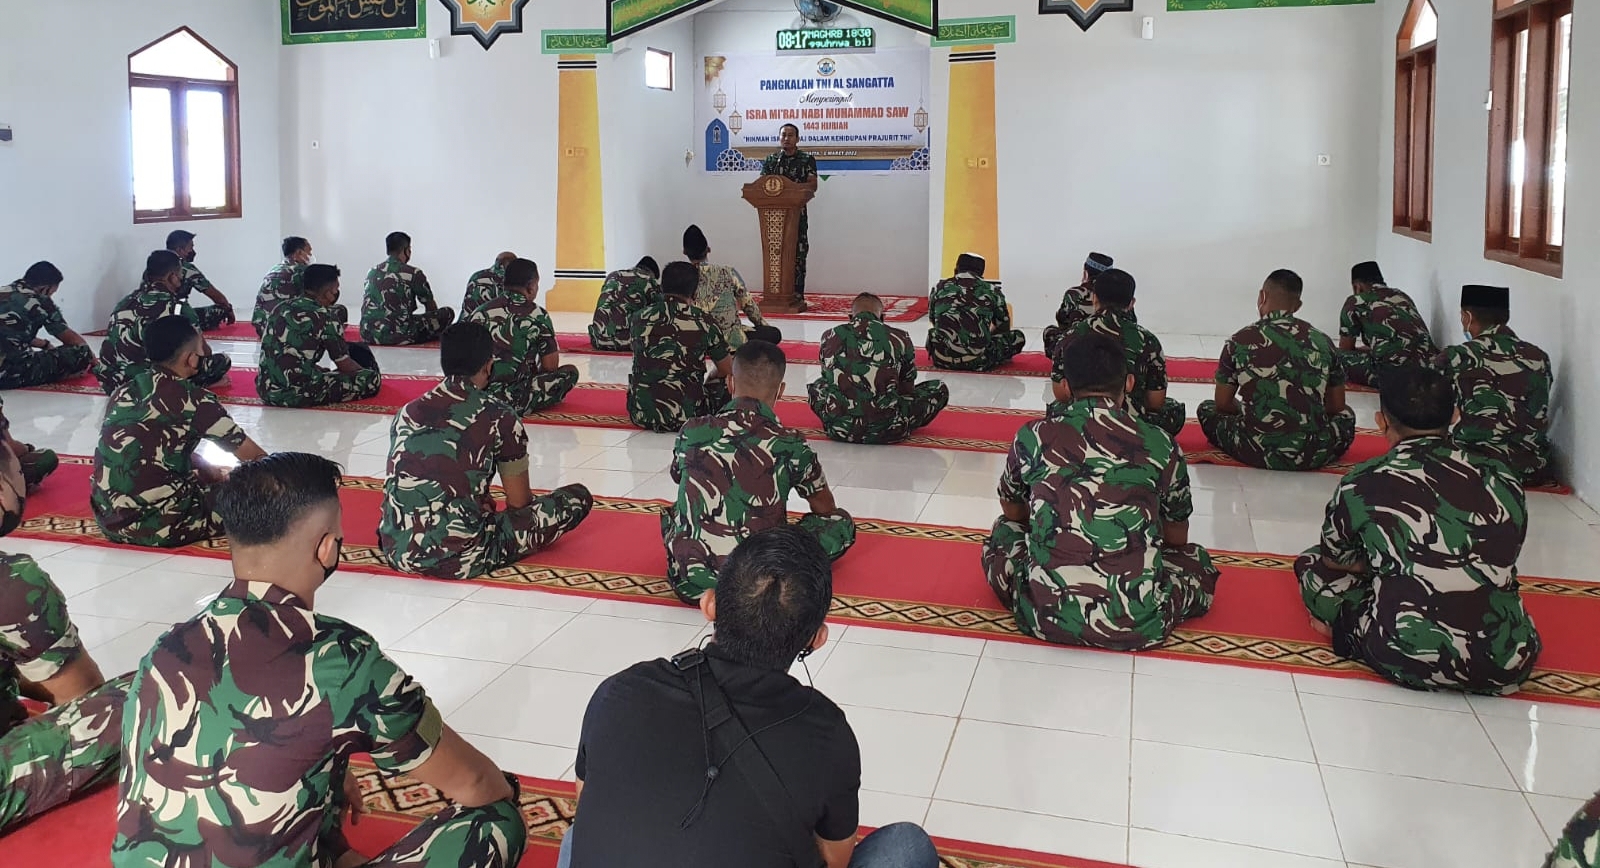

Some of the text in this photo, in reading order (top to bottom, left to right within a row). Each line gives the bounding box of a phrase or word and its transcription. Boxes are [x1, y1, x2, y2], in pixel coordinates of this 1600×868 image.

[778, 30, 807, 48] 08:17
[760, 76, 895, 90] PANGKALAN TNI AL SANGATTA
[745, 106, 909, 120] ISRA MI'RAJ NABI MUHAMMAD SAW
[803, 122, 820, 131] 1443
[831, 134, 867, 142] KEHIDUPAN
[868, 134, 898, 142] PRAJURIT
